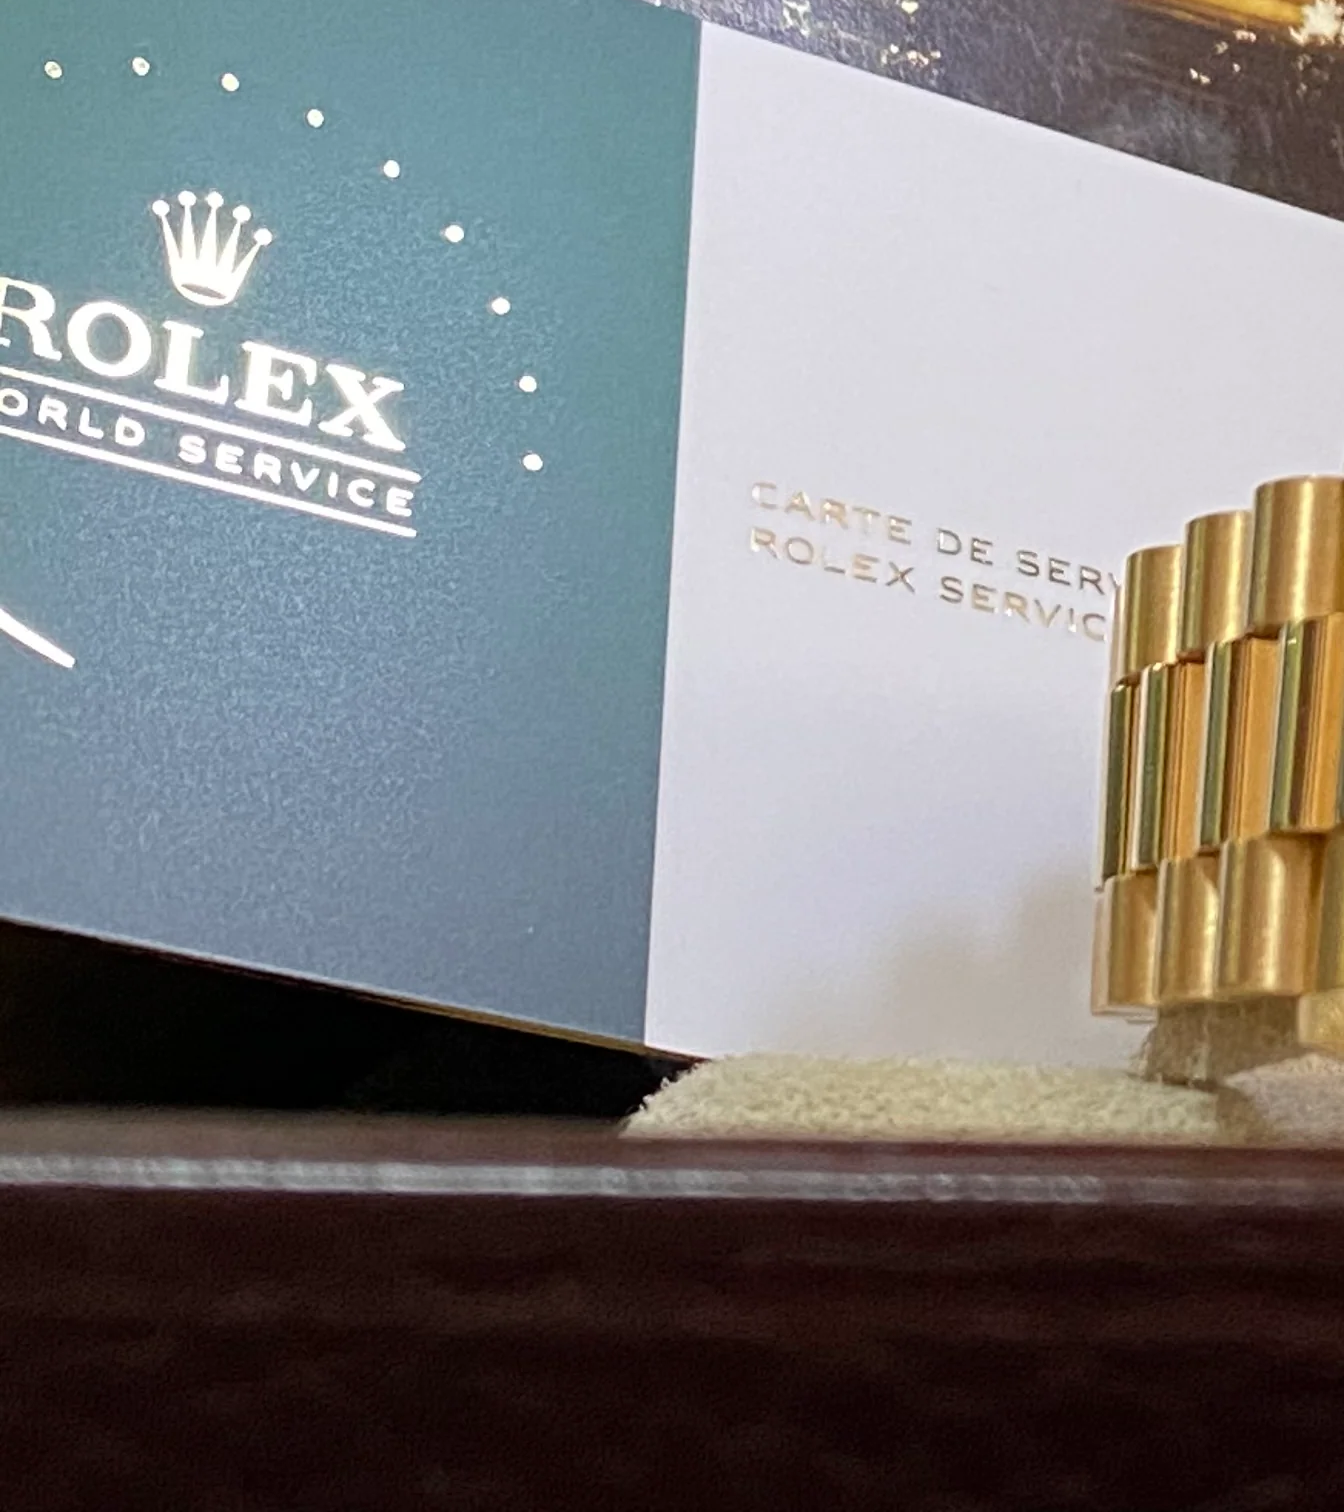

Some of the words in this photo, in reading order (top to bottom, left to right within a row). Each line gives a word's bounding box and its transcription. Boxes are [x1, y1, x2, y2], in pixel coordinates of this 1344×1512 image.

[0, 276, 408, 452] ROLEX
[177, 434, 415, 518] SERVICE
[751, 481, 913, 545] CARTE
[936, 528, 994, 567] DE
[751, 527, 917, 594] ROLEX
[939, 575, 1107, 645] SERVIC
